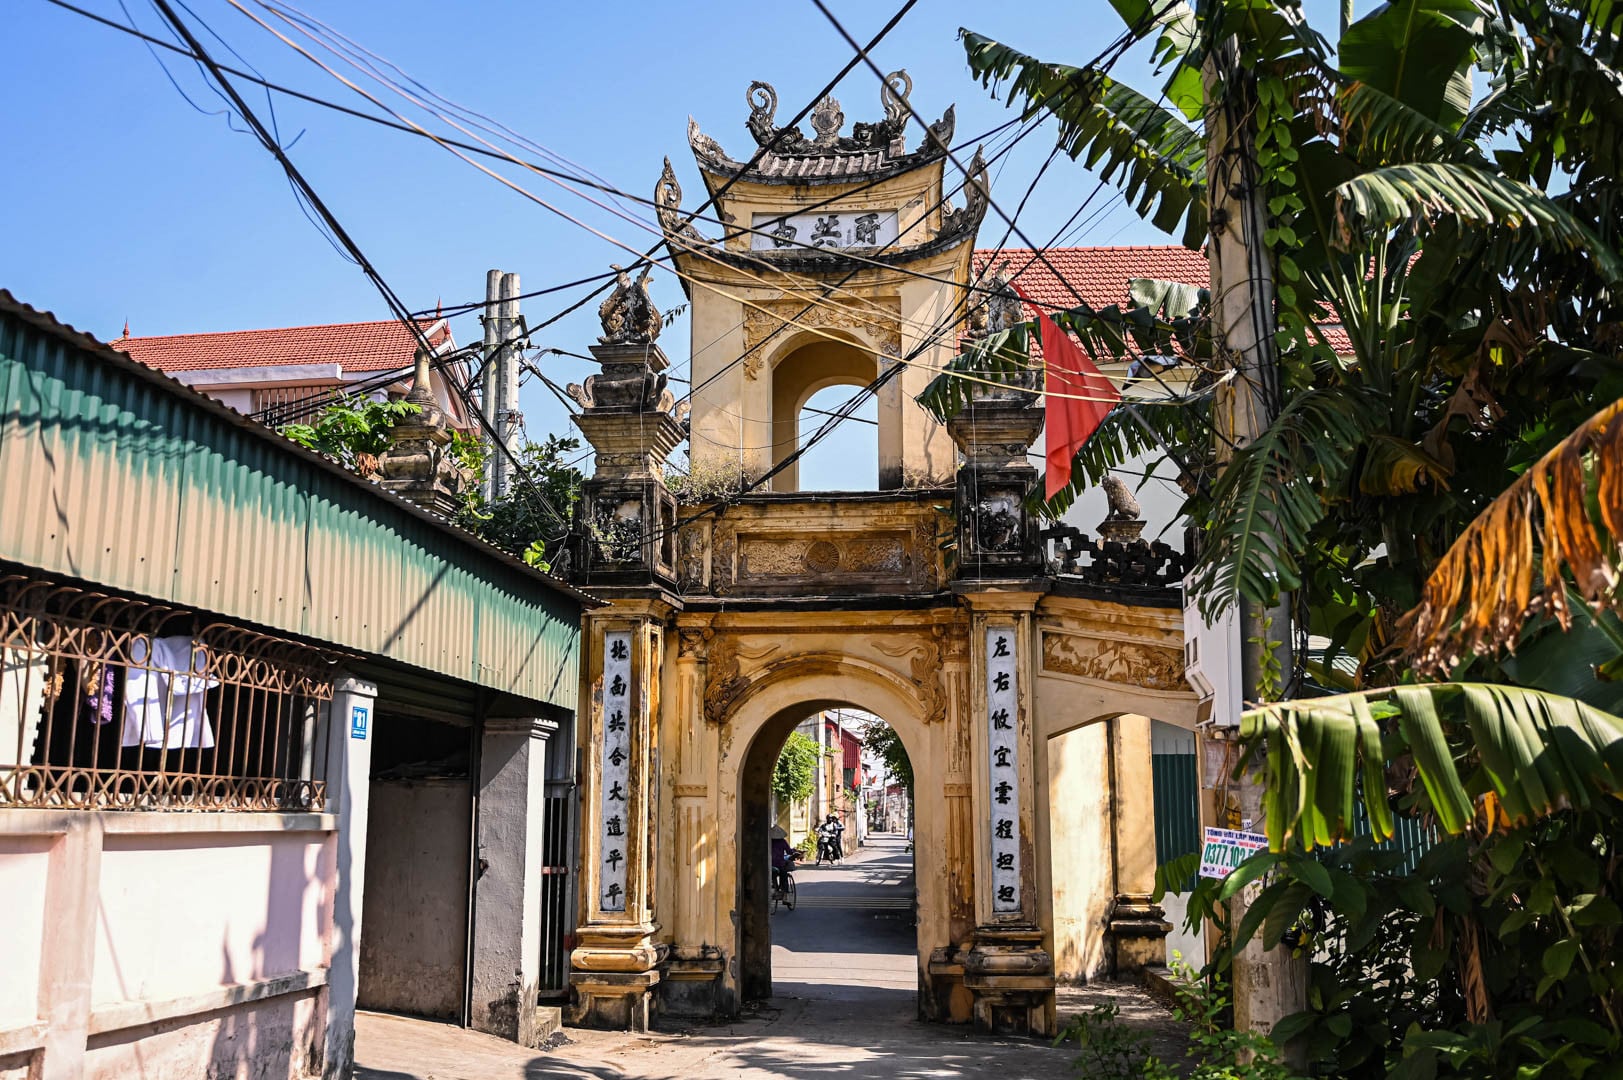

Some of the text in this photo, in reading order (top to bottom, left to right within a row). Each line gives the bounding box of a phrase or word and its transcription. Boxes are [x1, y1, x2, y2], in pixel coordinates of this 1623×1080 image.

[357, 711, 366, 728] 81
[605, 639, 628, 907] 北南共合大道平平
